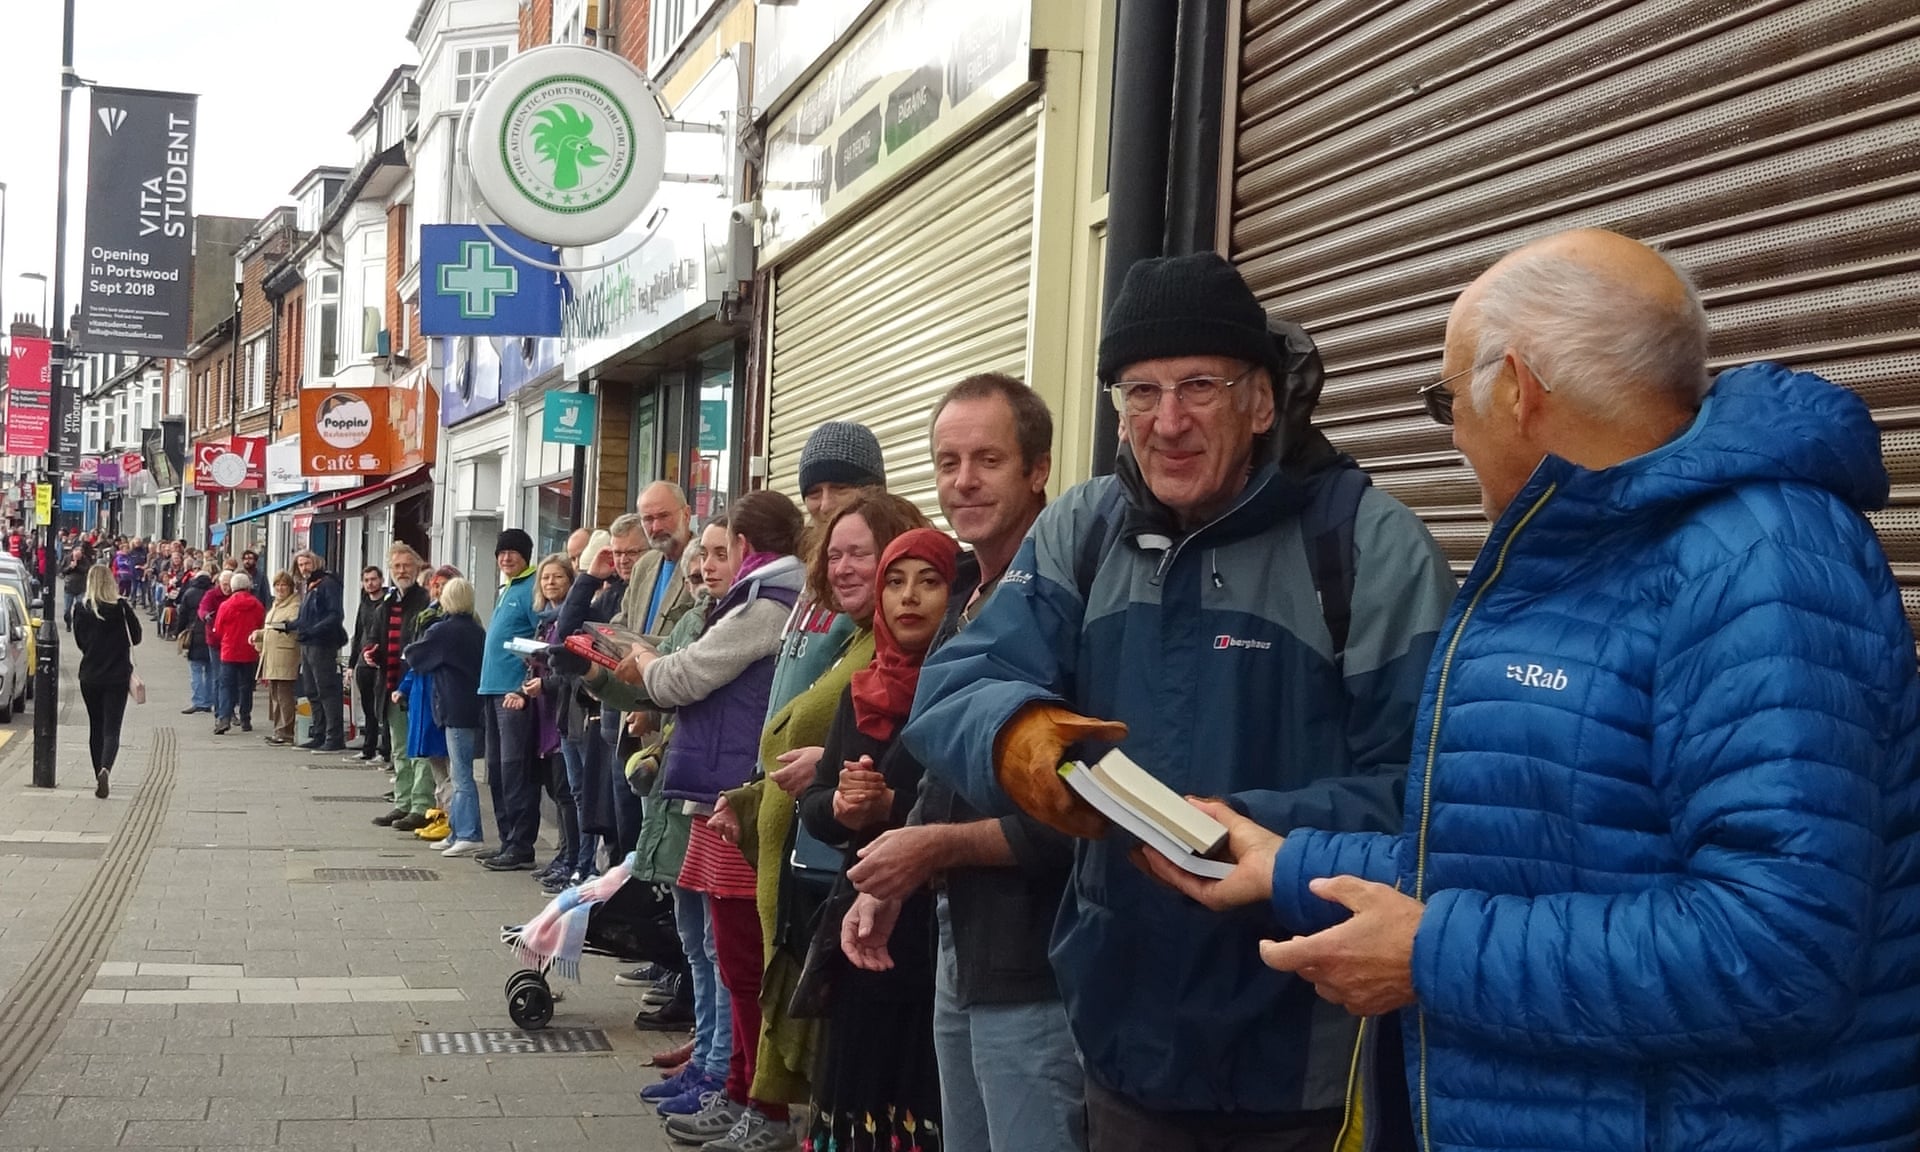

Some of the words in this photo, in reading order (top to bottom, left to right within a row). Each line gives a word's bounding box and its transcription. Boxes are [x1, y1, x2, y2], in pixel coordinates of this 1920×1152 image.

[541, 86, 605, 107] PORTSWOOD
[511, 96, 542, 152] AUTHENTIC
[603, 104, 620, 124] PIRI
[615, 126, 626, 149] PIRI
[164, 112, 191, 238] STUDENT
[512, 154, 528, 178] THE
[608, 149, 626, 181] TASTE
[139, 176, 163, 237] VITA
[91, 246, 149, 265] Opening
[90, 263, 103, 276] in
[106, 264, 179, 281] Portswood
[89, 280, 122, 296] Sept
[125, 282, 155, 296] 2018
[64, 413, 73, 434] VITA
[72, 393, 81, 433] STUDENT
[324, 417, 368, 430] Poppins
[311, 453, 354, 471] Café
[1230, 637, 1272, 649] berghaus
[1521, 664, 1568, 691] Rab
